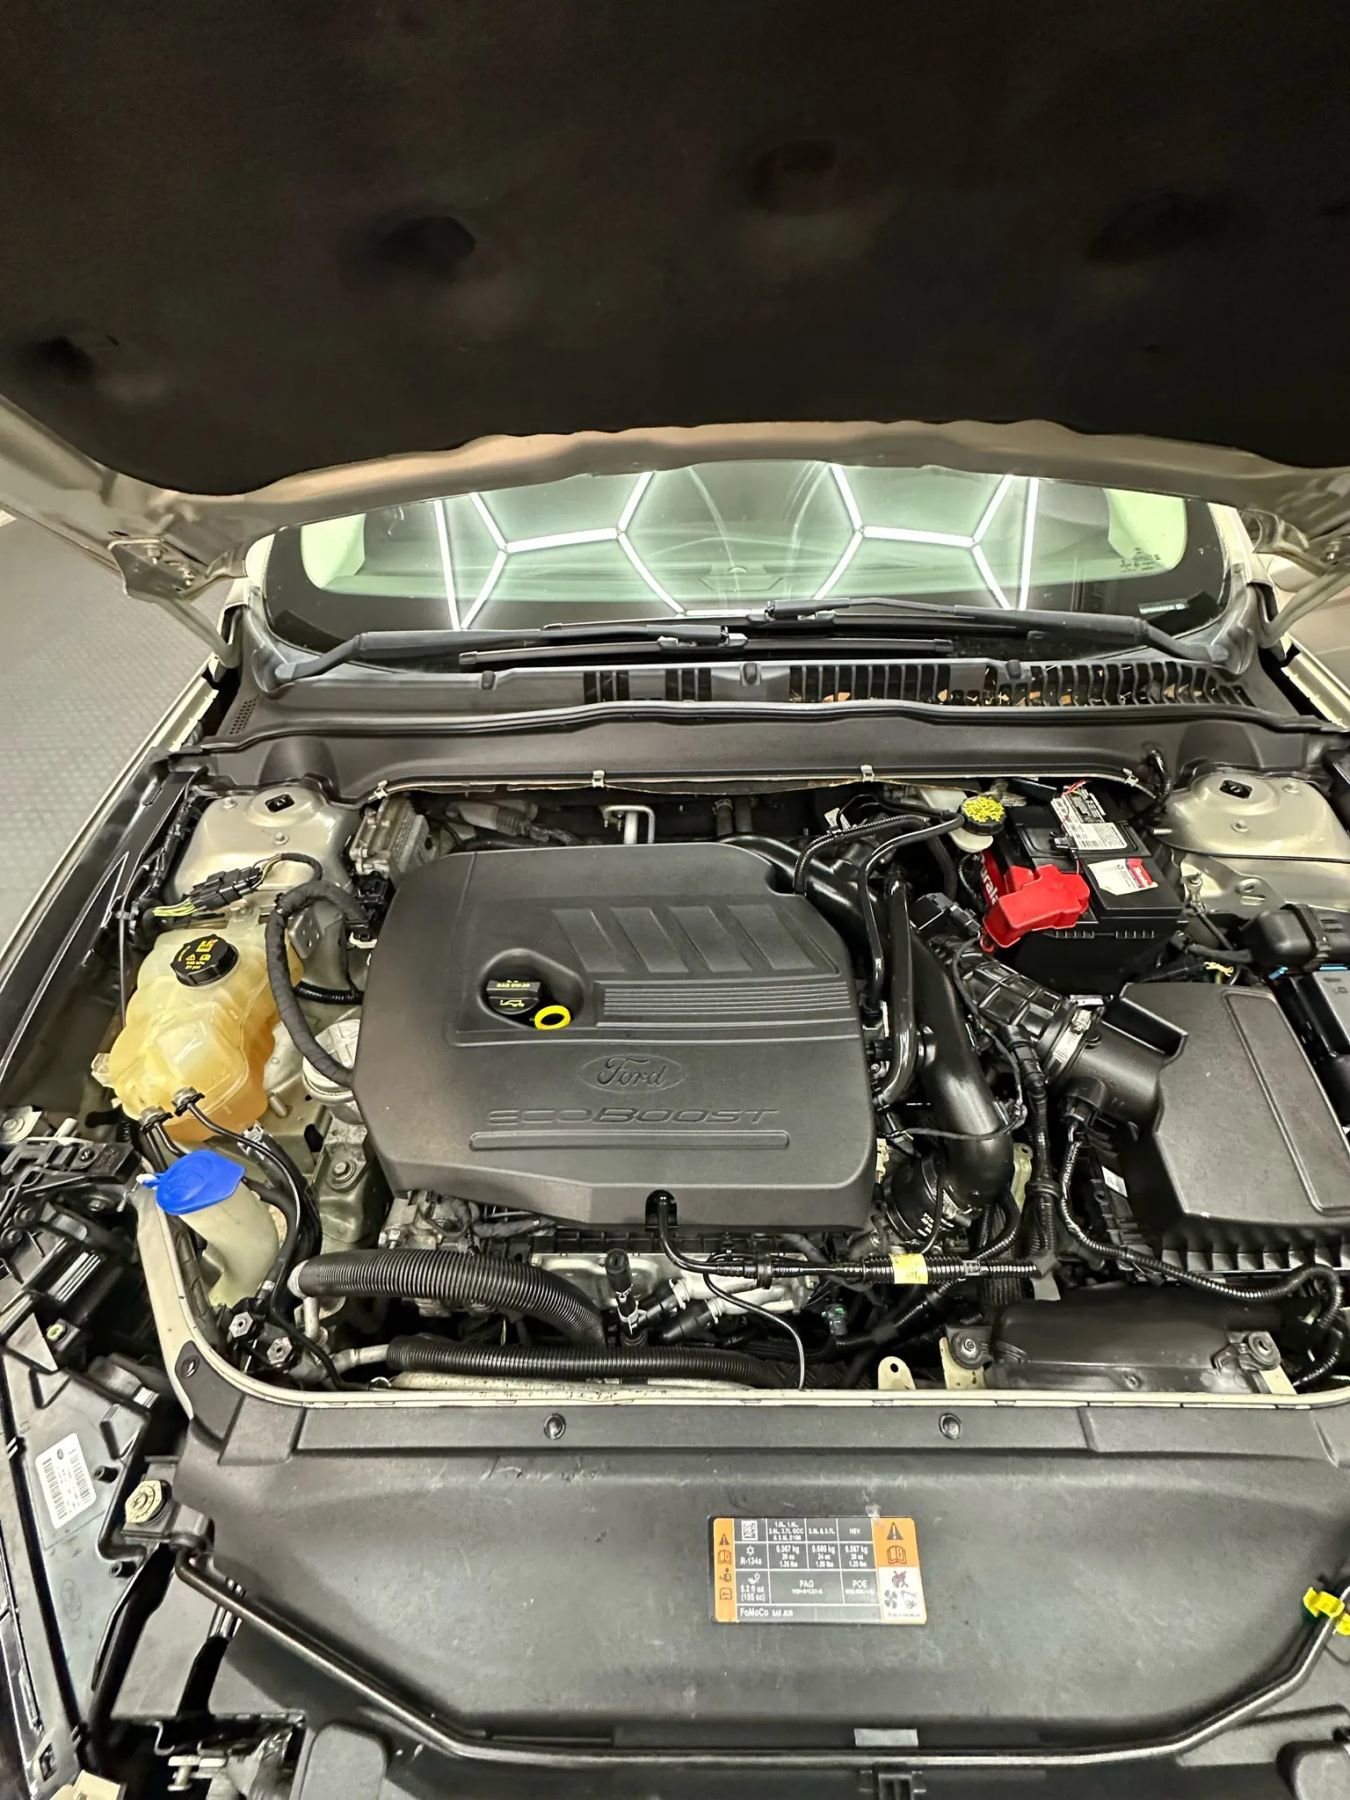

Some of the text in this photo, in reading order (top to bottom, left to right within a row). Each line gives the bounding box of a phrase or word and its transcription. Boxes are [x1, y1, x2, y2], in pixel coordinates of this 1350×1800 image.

[597, 1055, 667, 1087] Ford
[489, 1107, 779, 1125] ECOBOOST
[792, 1545, 800, 1554] kg
[828, 1545, 835, 1554] kg
[861, 1545, 868, 1554] kg
[740, 1556, 762, 1565] R-134a
[799, 1579, 815, 1588] PAG
[852, 1579, 868, 1588] POE
[740, 1607, 769, 1617] FoMoCo
